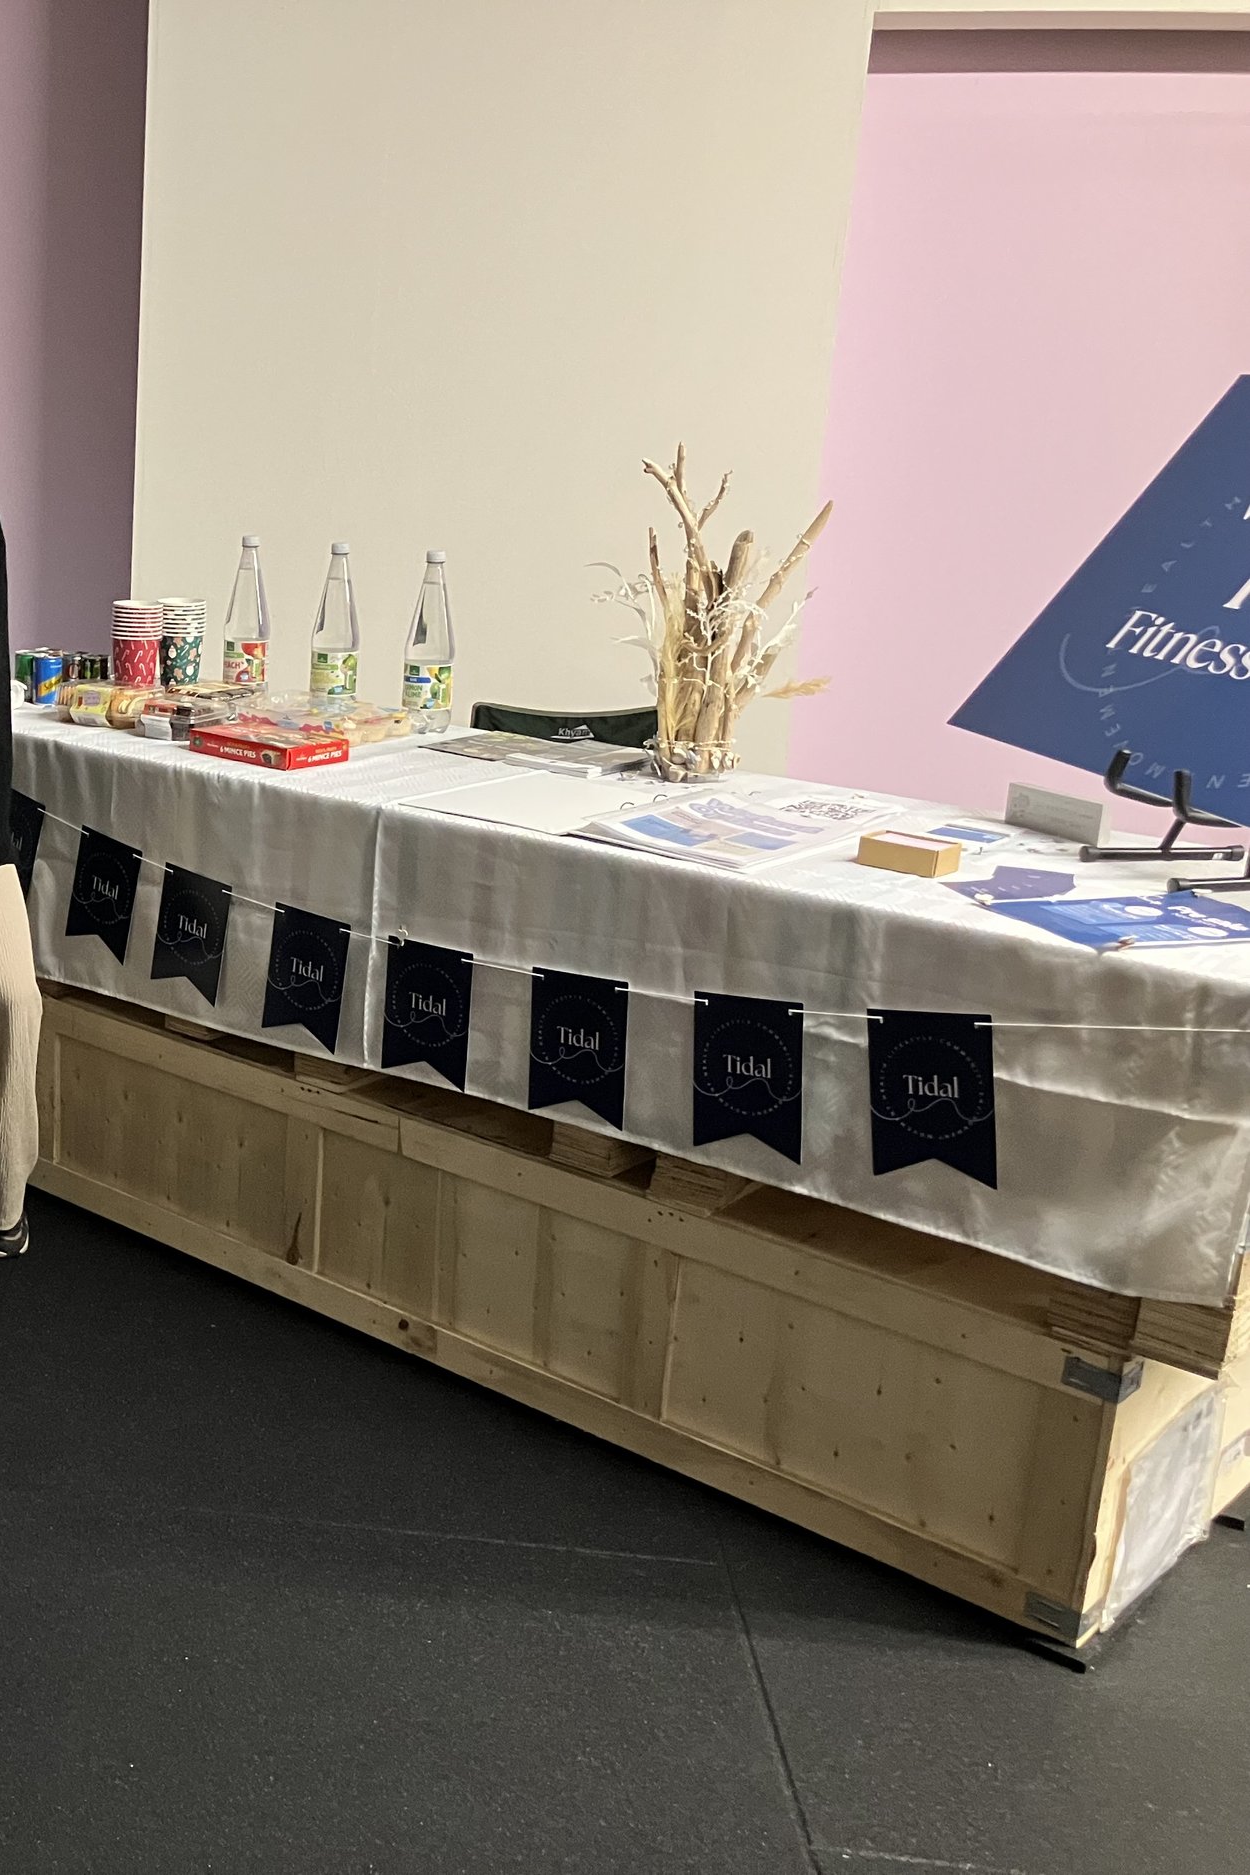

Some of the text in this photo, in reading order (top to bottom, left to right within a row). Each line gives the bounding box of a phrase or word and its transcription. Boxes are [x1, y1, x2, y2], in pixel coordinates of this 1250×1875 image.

[92, 875, 119, 901] Tidal
[177, 914, 207, 940] Tidal
[290, 957, 324, 982] Tidal
[408, 991, 447, 1016] Tidal
[556, 1025, 600, 1051] Tidal
[723, 1053, 772, 1079] Tidal
[902, 1074, 960, 1098] Tidal
